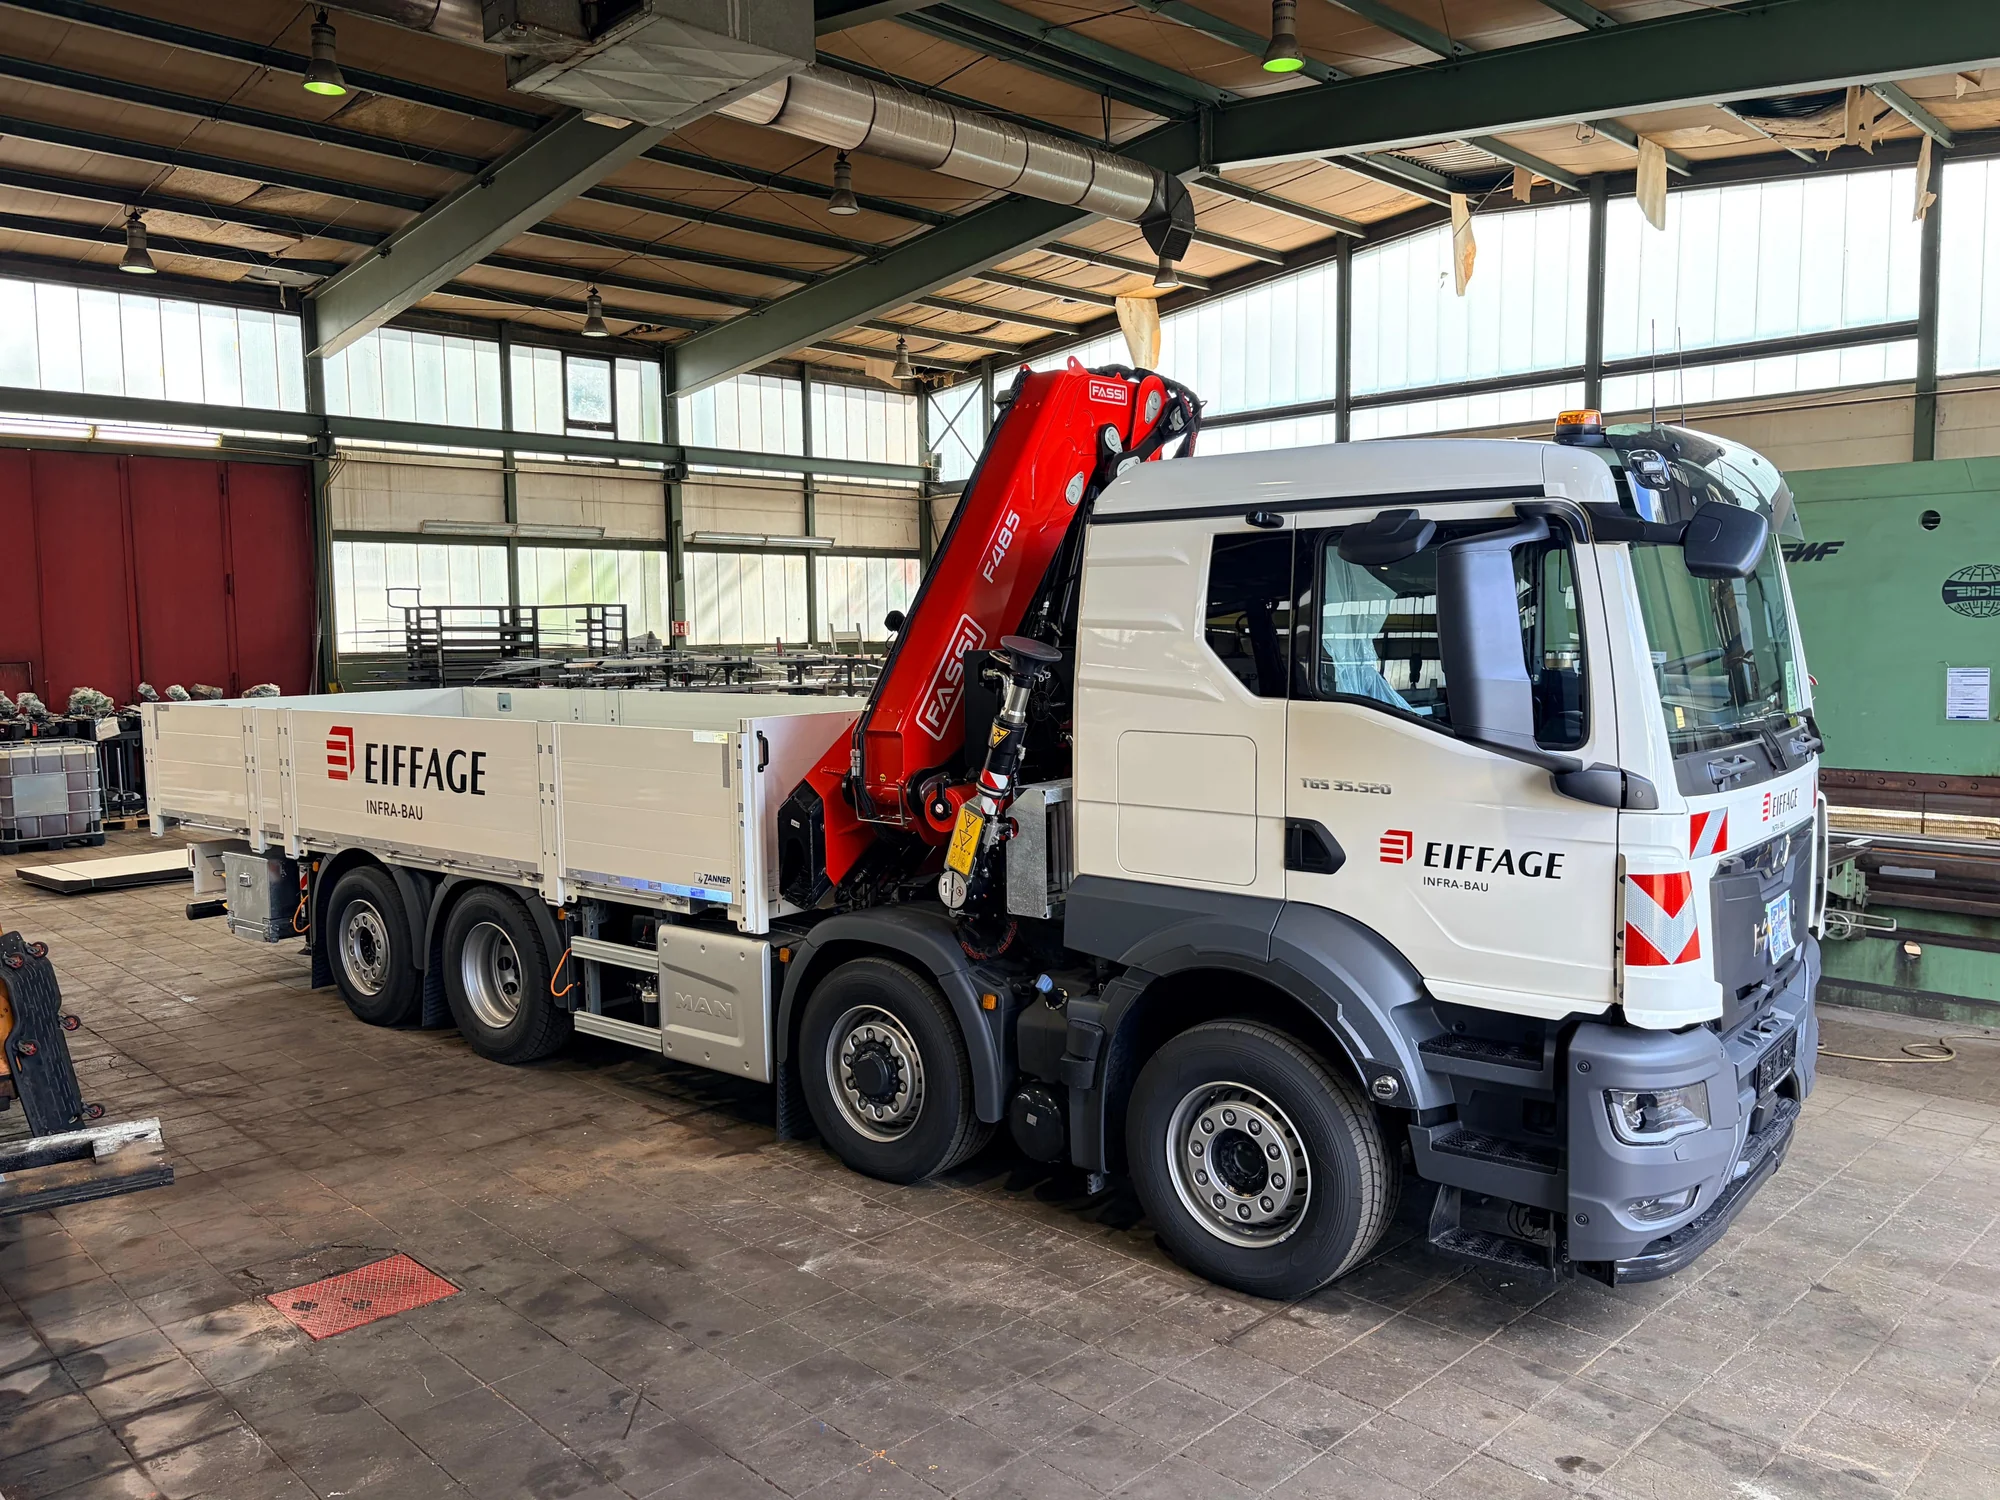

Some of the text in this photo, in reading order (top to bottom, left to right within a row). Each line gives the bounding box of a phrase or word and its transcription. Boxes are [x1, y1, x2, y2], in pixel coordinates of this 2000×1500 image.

[1092, 385, 1125, 401] FASSI
[982, 509, 1021, 584] F485
[925, 626, 978, 728] FASSI
[365, 742, 487, 796] EIFFAGE
[1300, 777, 1392, 795] TGS 35.520
[366, 799, 423, 820] INFRA-BAU
[1772, 787, 1798, 818] EIFFAGE
[1423, 841, 1565, 880] EIFFAGE
[703, 873, 732, 885] ZANNER
[1423, 876, 1489, 892] INFRA-BAU
[675, 992, 733, 1021] MAN
